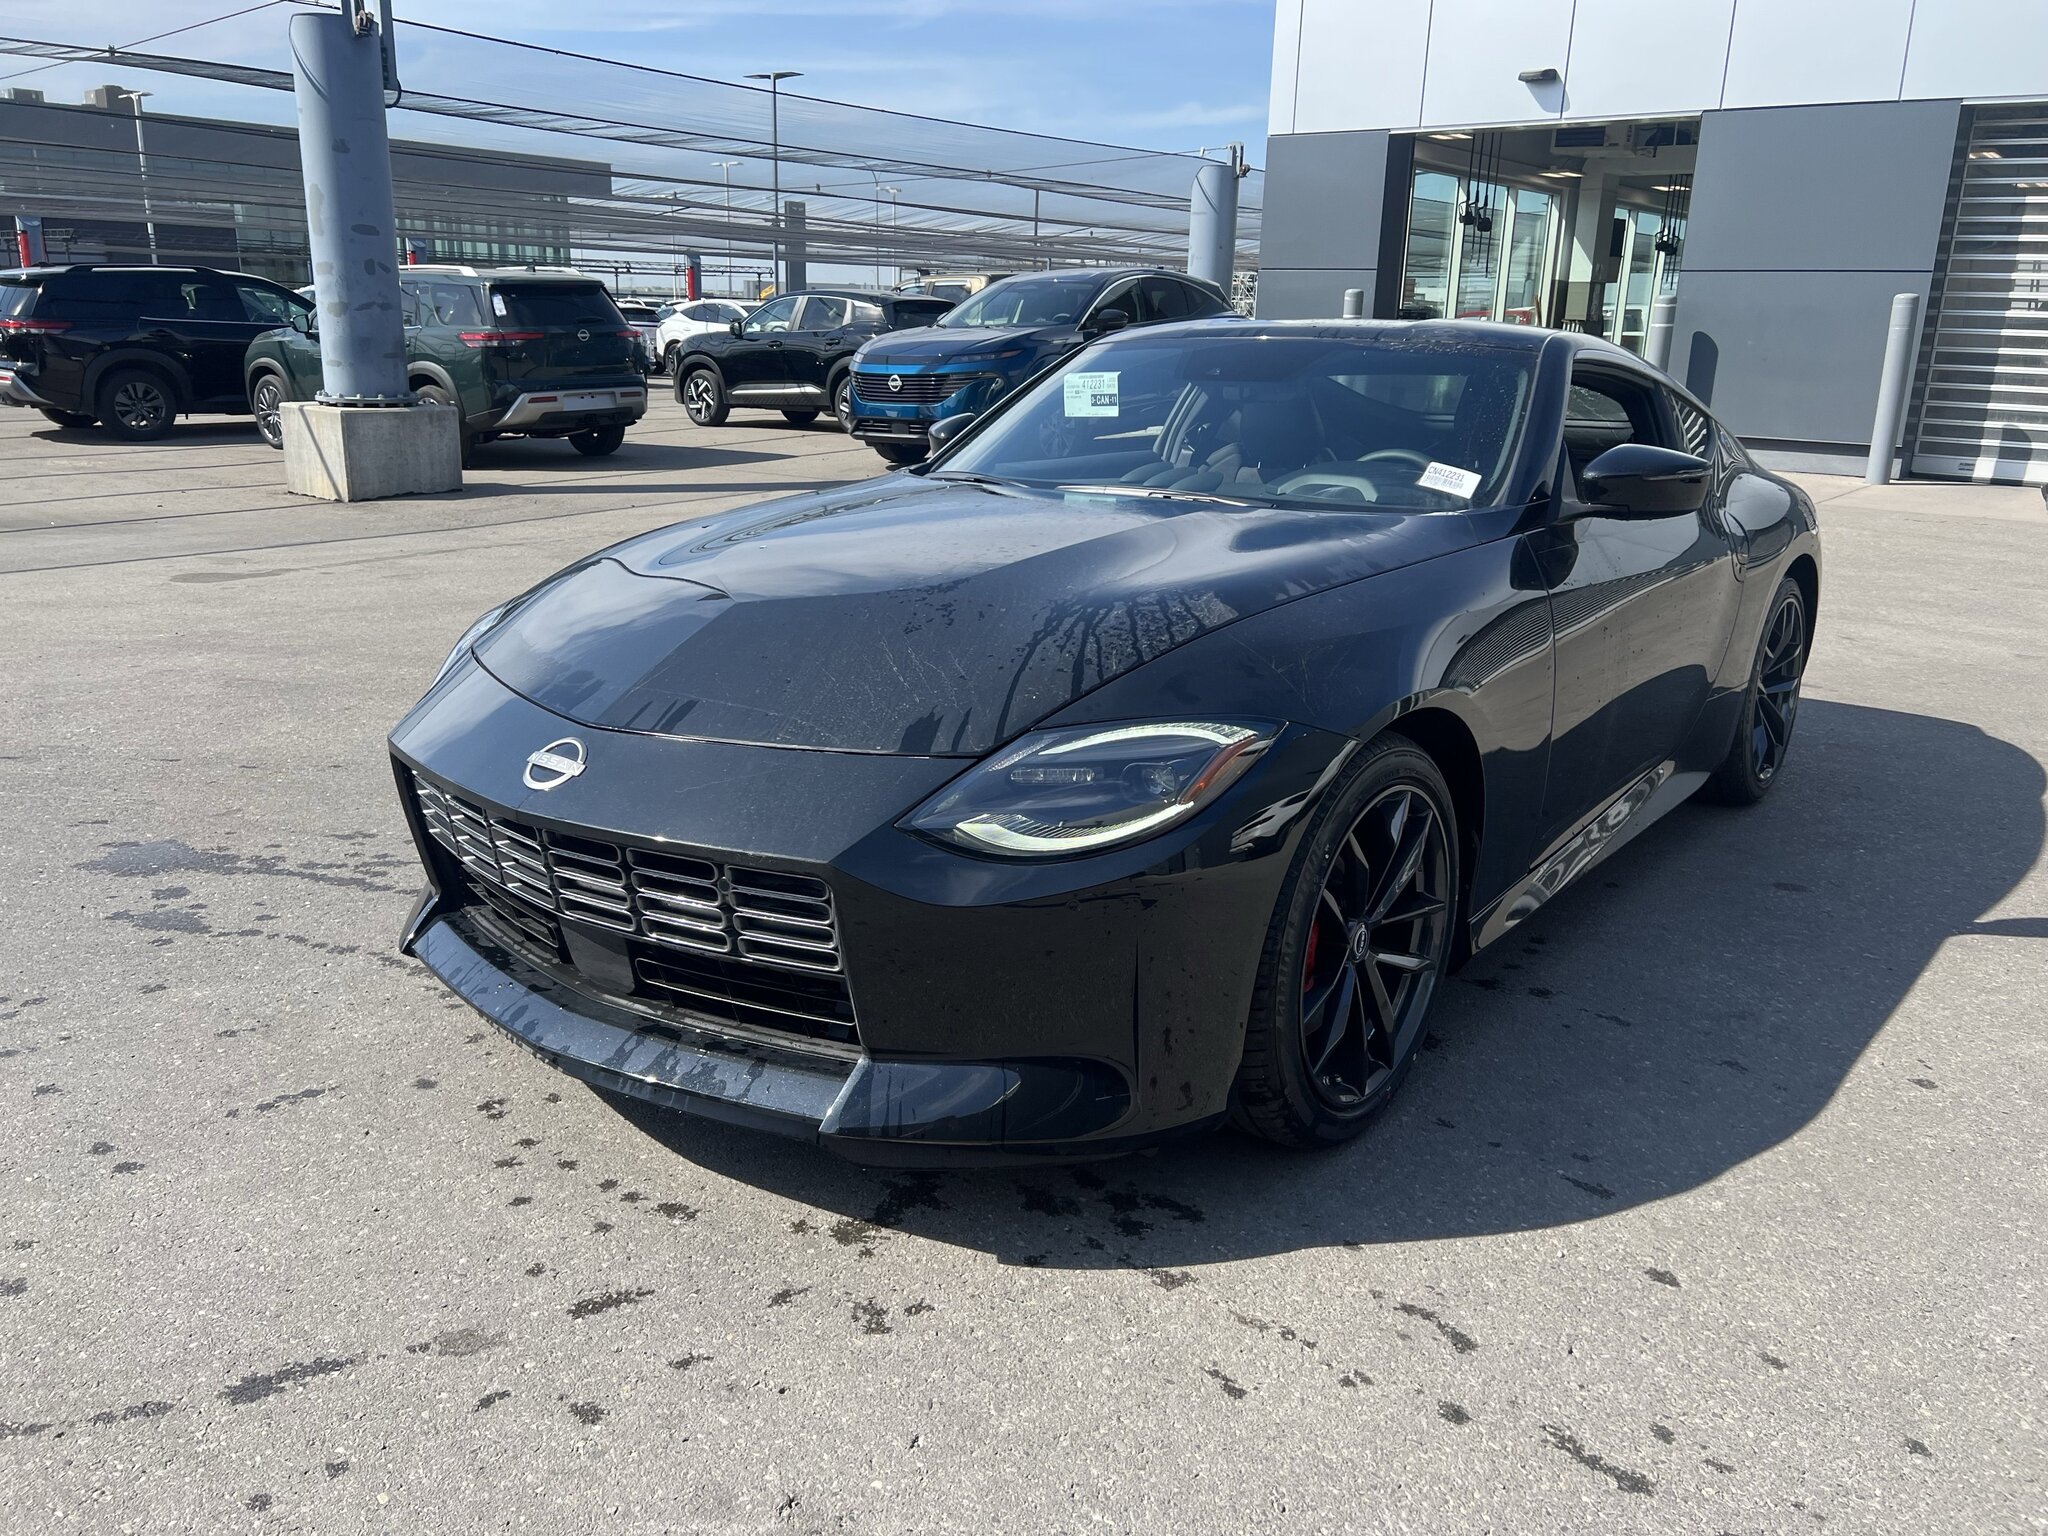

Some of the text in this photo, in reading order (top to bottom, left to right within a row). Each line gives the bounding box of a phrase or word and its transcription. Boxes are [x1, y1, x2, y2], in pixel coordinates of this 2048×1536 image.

[1082, 379, 1105, 390] 412231
[1427, 465, 1465, 482] CN412231
[528, 752, 584, 775] NISSAN
